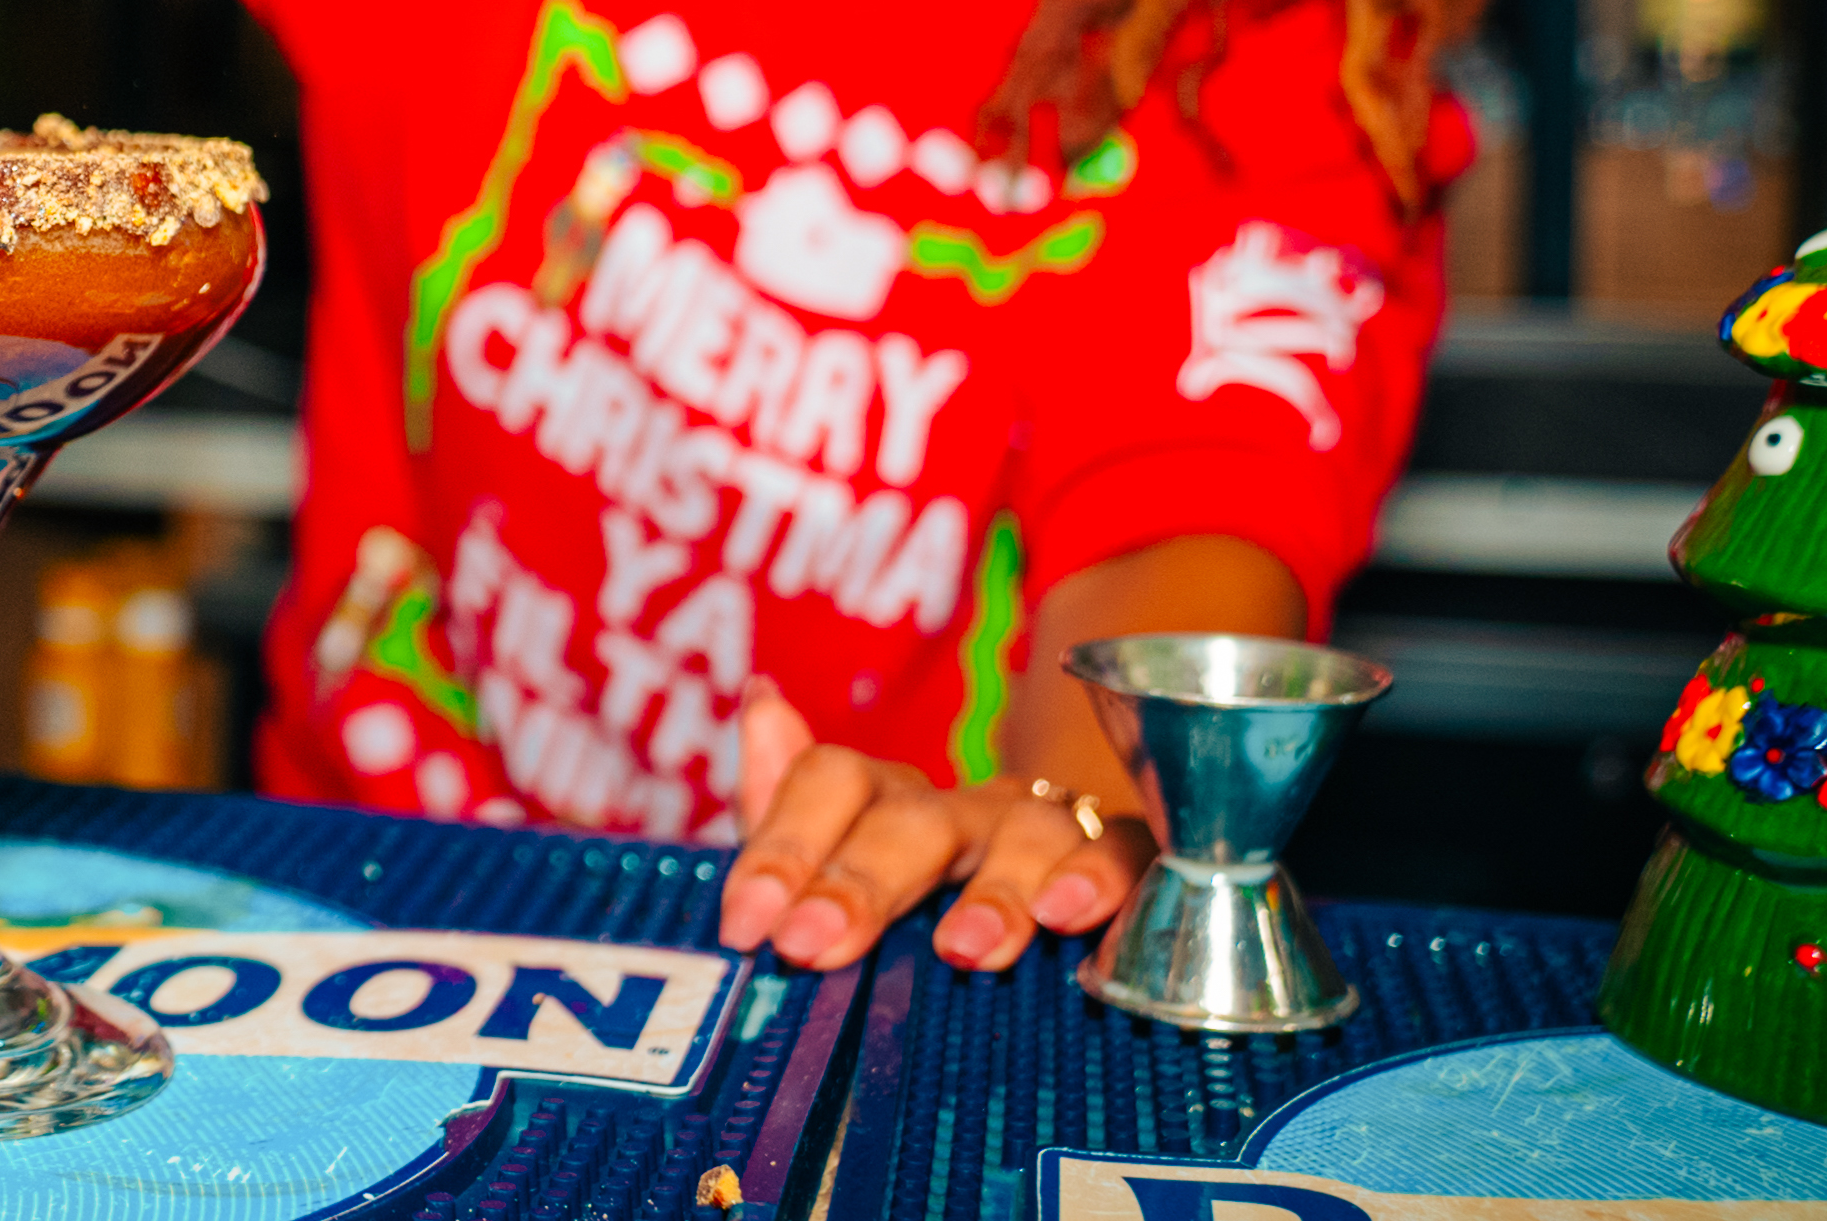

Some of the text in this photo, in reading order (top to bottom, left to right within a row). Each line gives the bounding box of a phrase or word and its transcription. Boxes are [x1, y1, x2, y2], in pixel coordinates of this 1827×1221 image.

[446, 282, 968, 635] CHRISTMA
[580, 204, 967, 488] MERRY
[450, 500, 743, 800] FILTH
